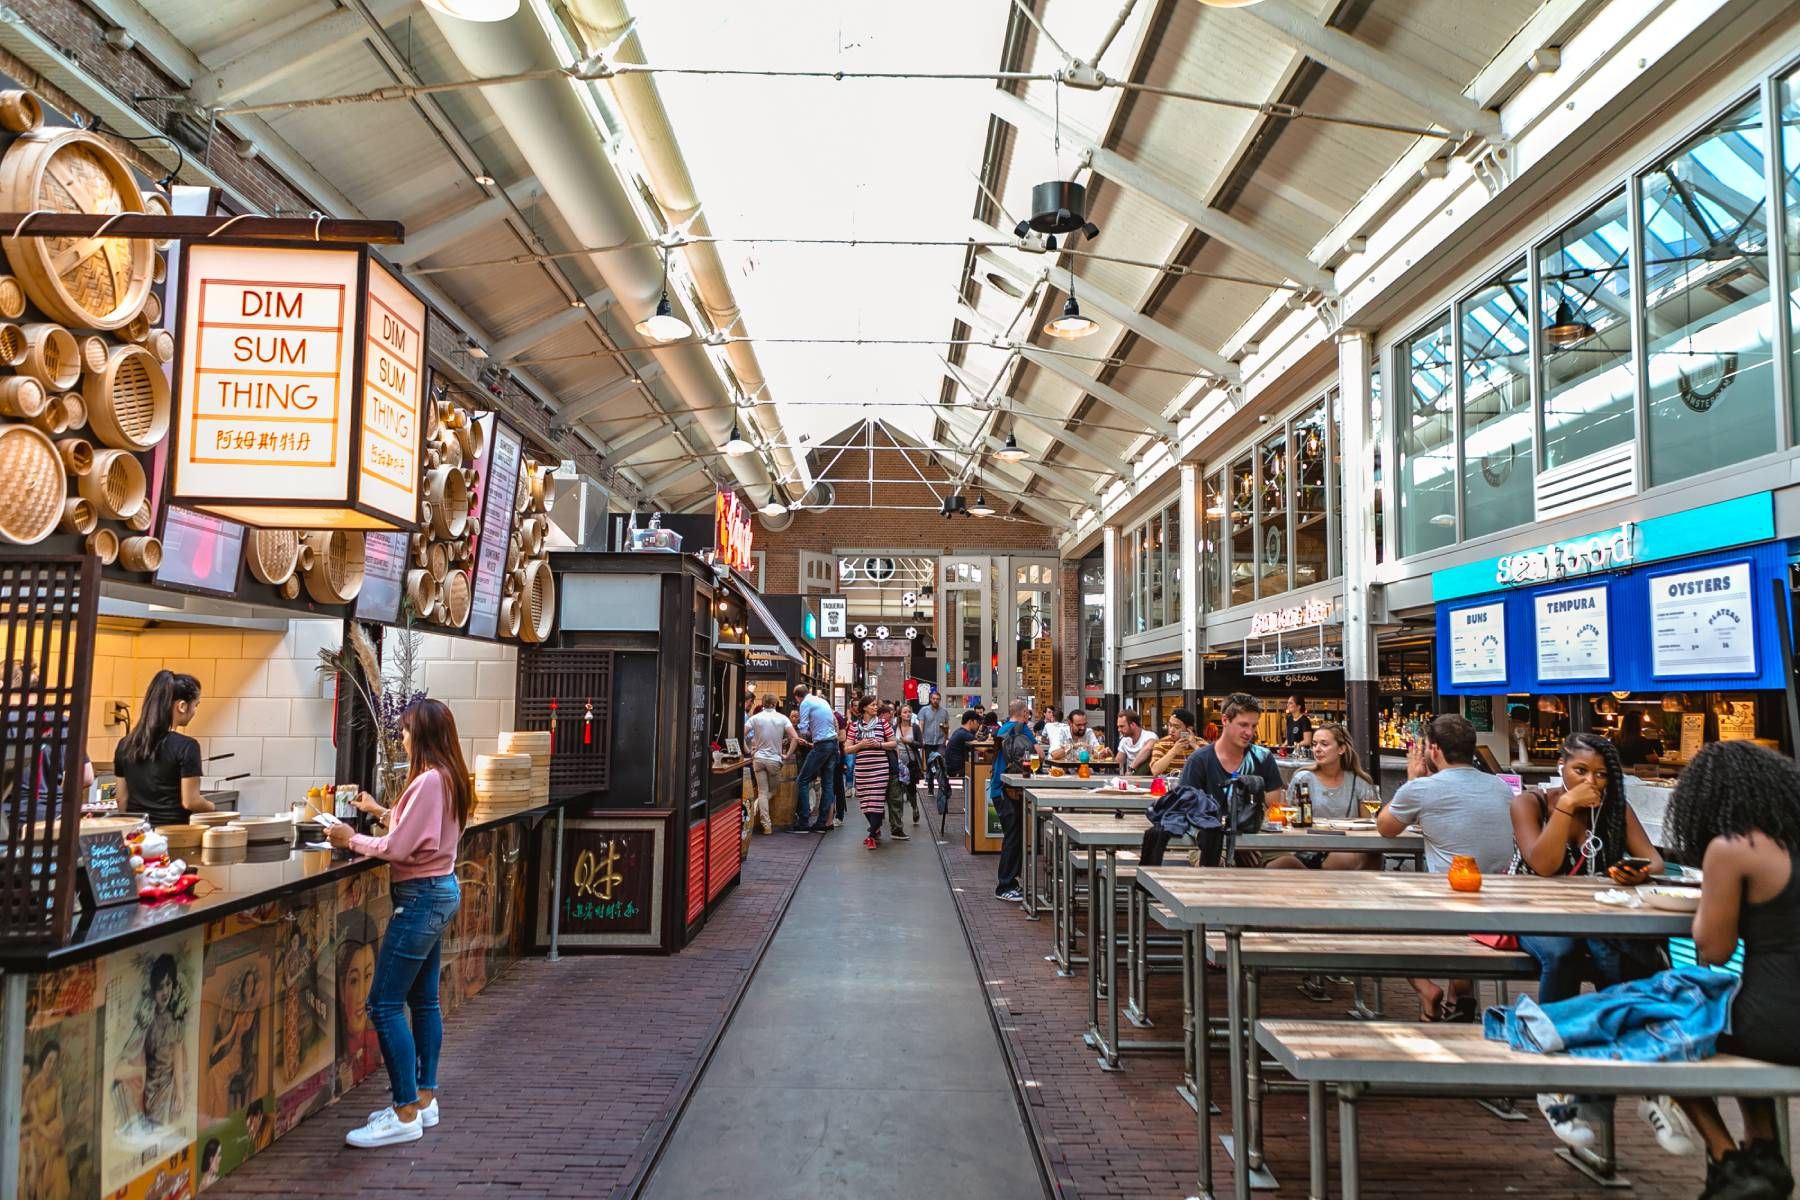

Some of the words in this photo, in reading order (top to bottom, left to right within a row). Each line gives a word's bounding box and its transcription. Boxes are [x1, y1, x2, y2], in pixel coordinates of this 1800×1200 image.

[241, 290, 303, 319] DIM
[382, 314, 405, 353] DIM
[233, 336, 307, 365] SUM
[378, 357, 406, 396] SUM
[217, 381, 318, 410] THING
[372, 397, 408, 438] THING
[215, 429, 311, 451] 阿姆斯特丹
[1668, 576, 1731, 597] OYSTERS
[1467, 612, 1487, 625] BUNS
[1547, 597, 1595, 614] TEMPURA
